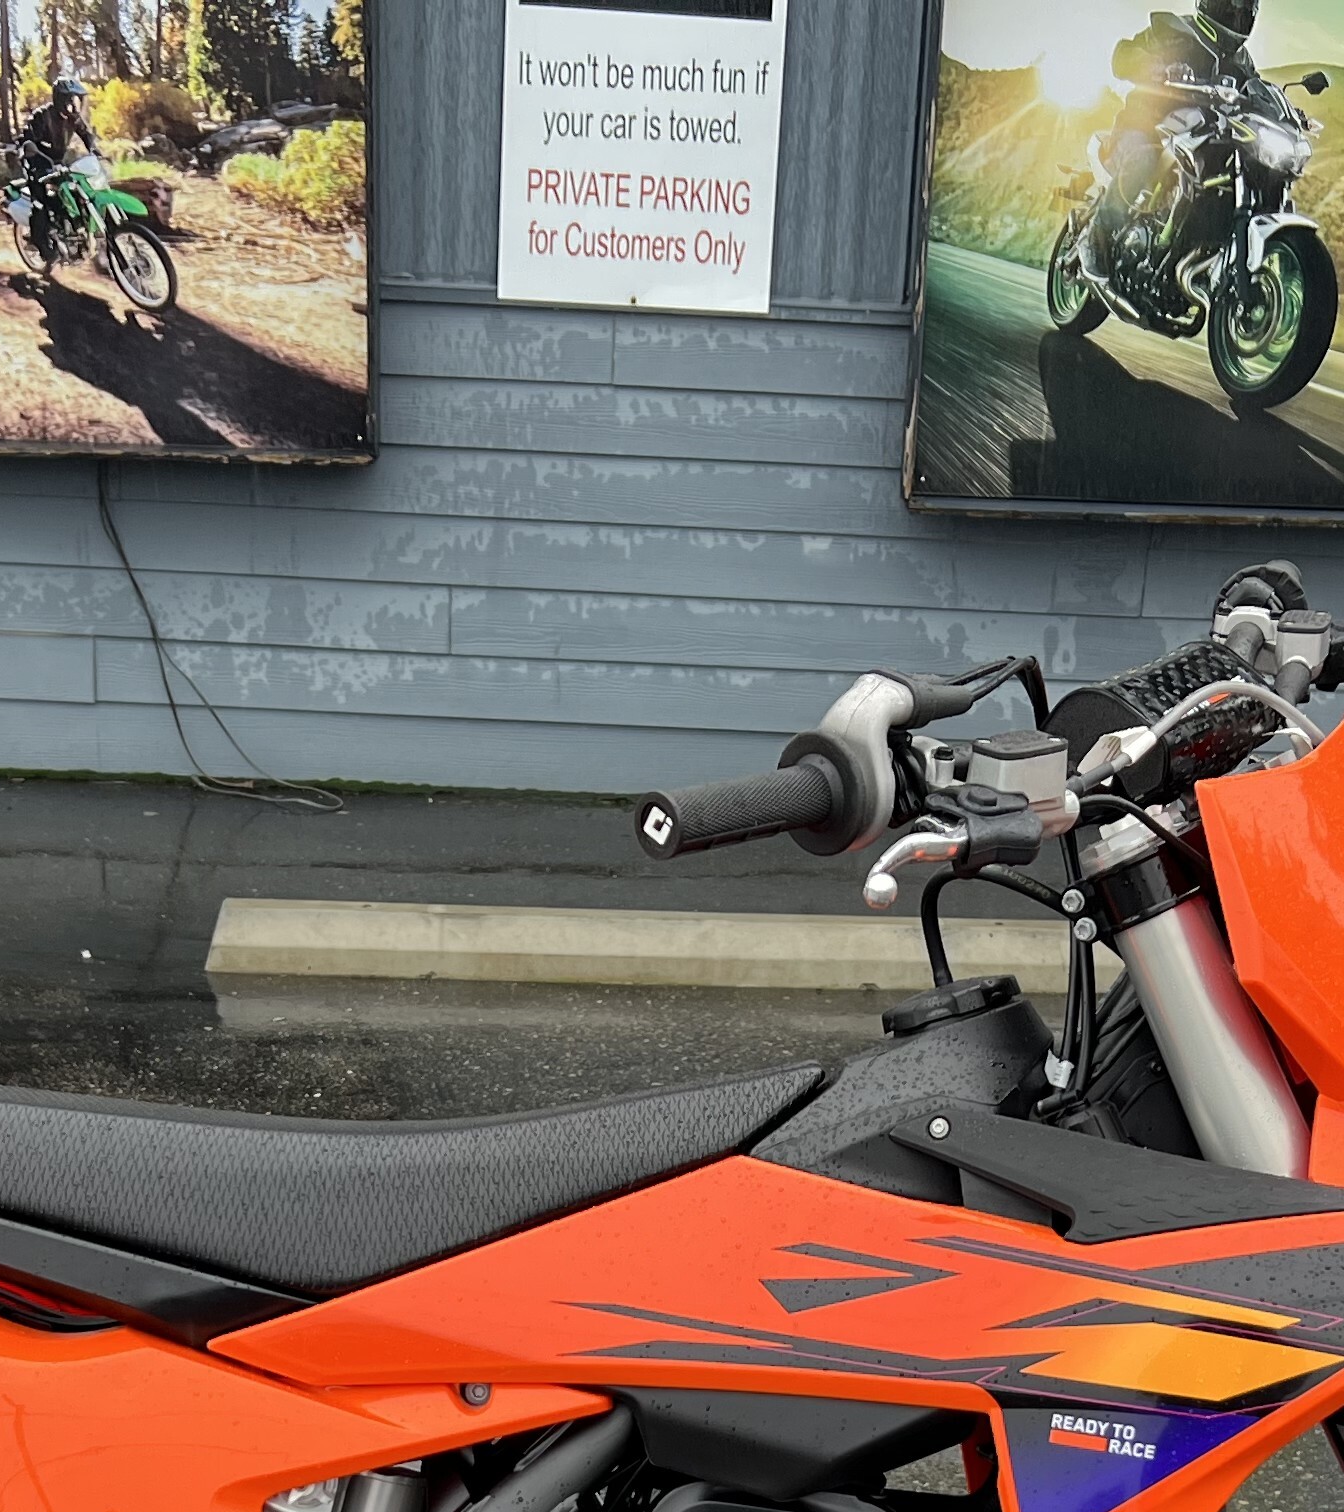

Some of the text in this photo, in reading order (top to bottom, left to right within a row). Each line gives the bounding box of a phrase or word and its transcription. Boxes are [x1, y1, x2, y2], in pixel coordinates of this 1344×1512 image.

[518, 51, 770, 95] It won't be much fun if
[543, 107, 742, 145] your car is towed.
[527, 168, 751, 215] PRIVATE PARKING
[528, 220, 746, 275] for Customers Only
[1050, 1413, 1136, 1440] READY TO
[1108, 1439, 1156, 1459] RACE
